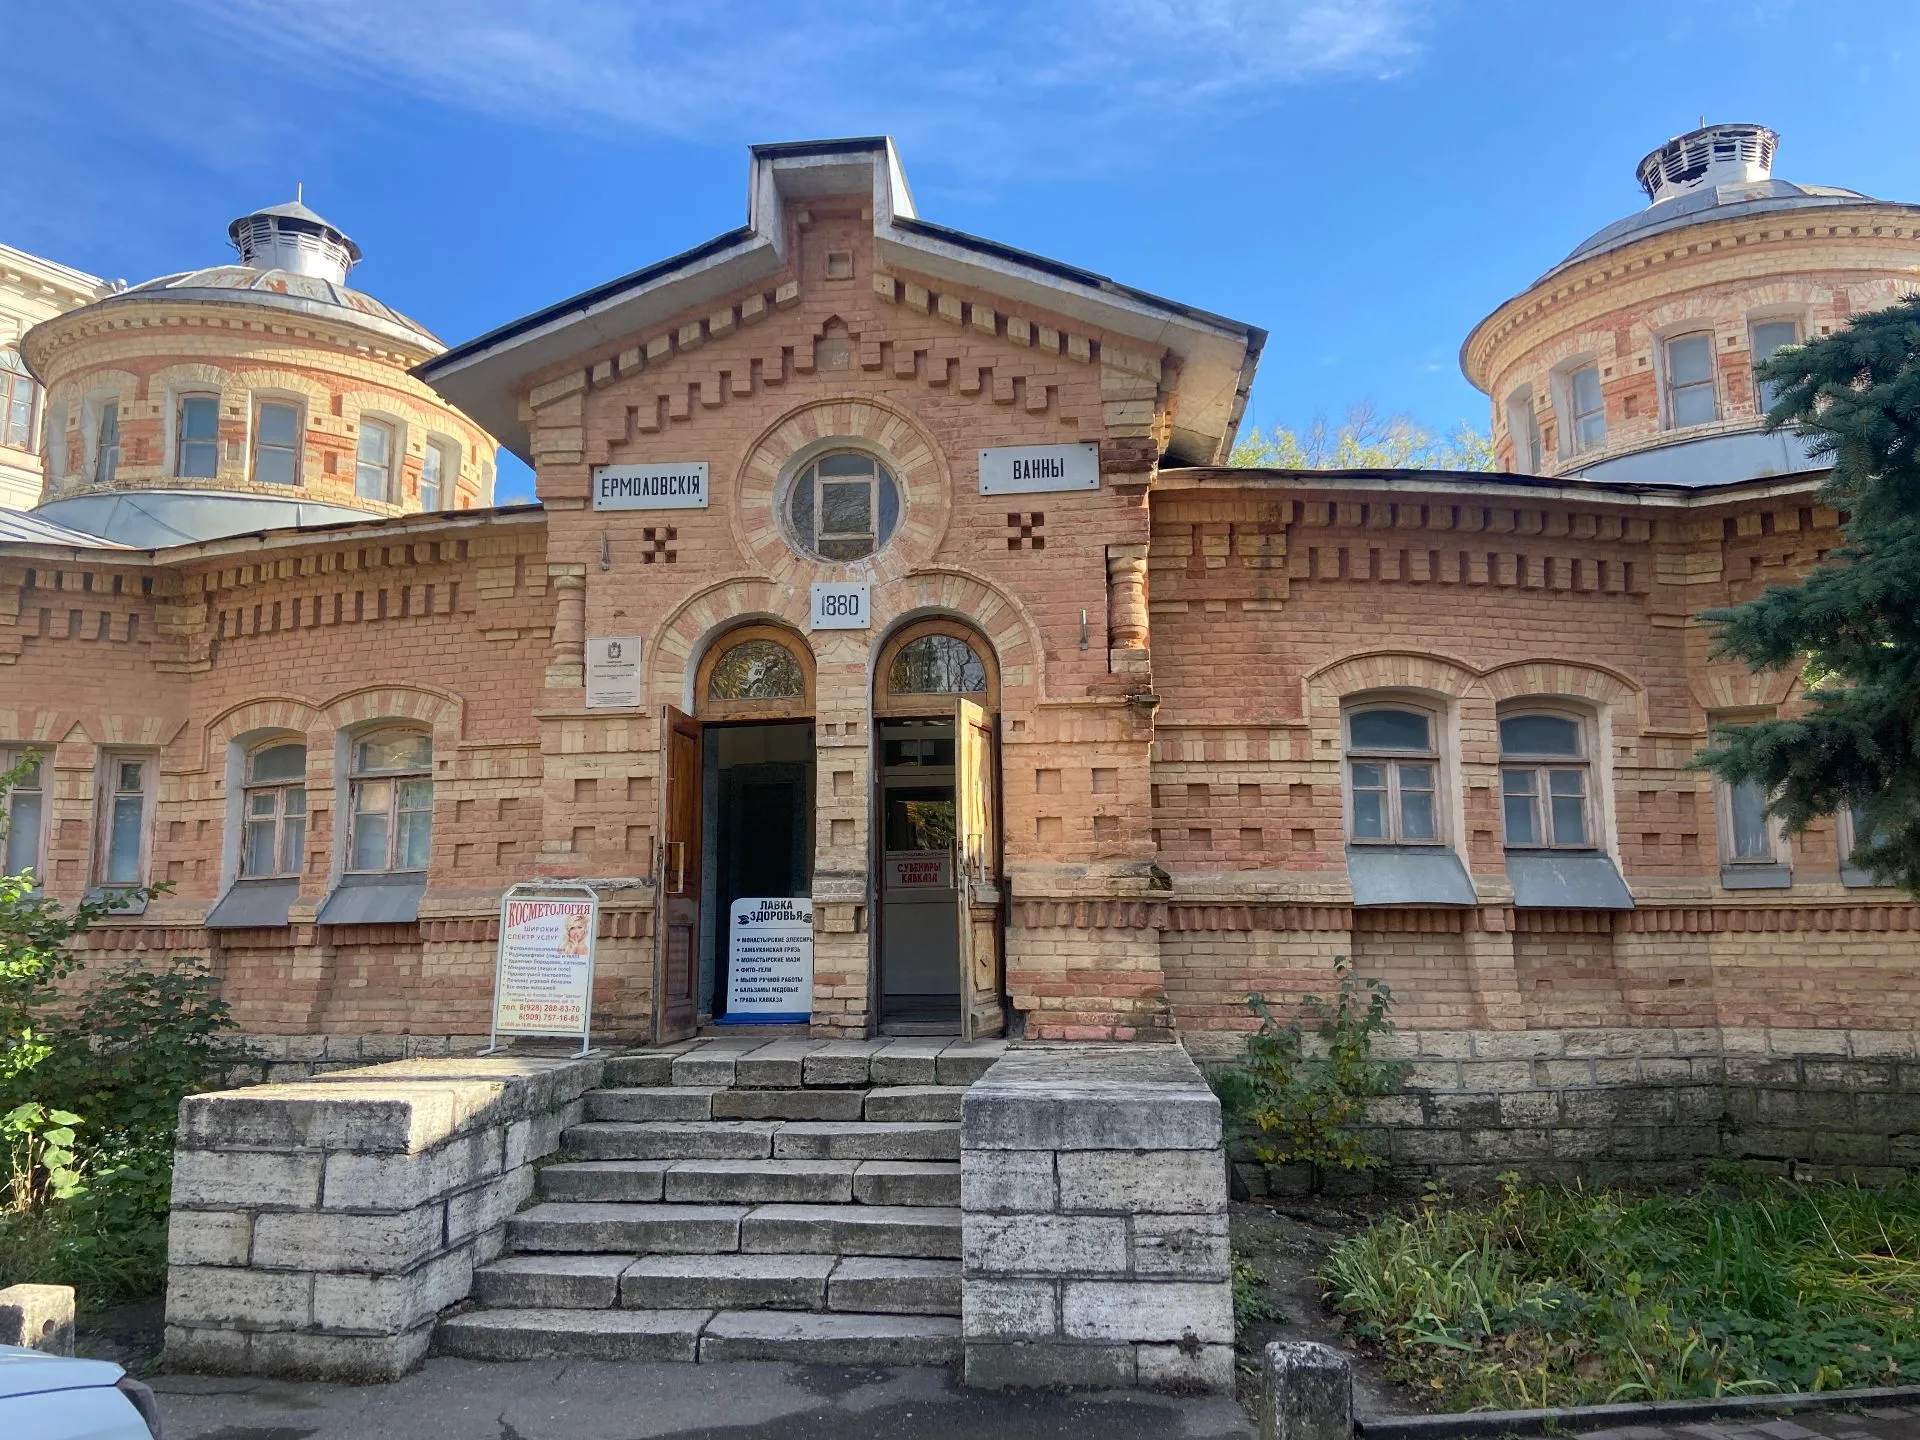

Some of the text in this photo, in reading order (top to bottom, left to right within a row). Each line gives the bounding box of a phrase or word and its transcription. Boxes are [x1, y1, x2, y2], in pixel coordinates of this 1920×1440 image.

[1013, 458, 1064, 480] ВАННЫ
[601, 475, 700, 497] ЕРМОЛОВСКІЯ
[821, 594, 858, 616] 1880
[897, 863, 941, 872] СУВЕНИРЫ
[901, 873, 938, 883] КАВКАЗА
[760, 900, 793, 910] ЛАВКА
[508, 902, 590, 927] КОСМЕТОЛОГИЯ
[750, 911, 803, 922] ЗДОРОВЬЯ
